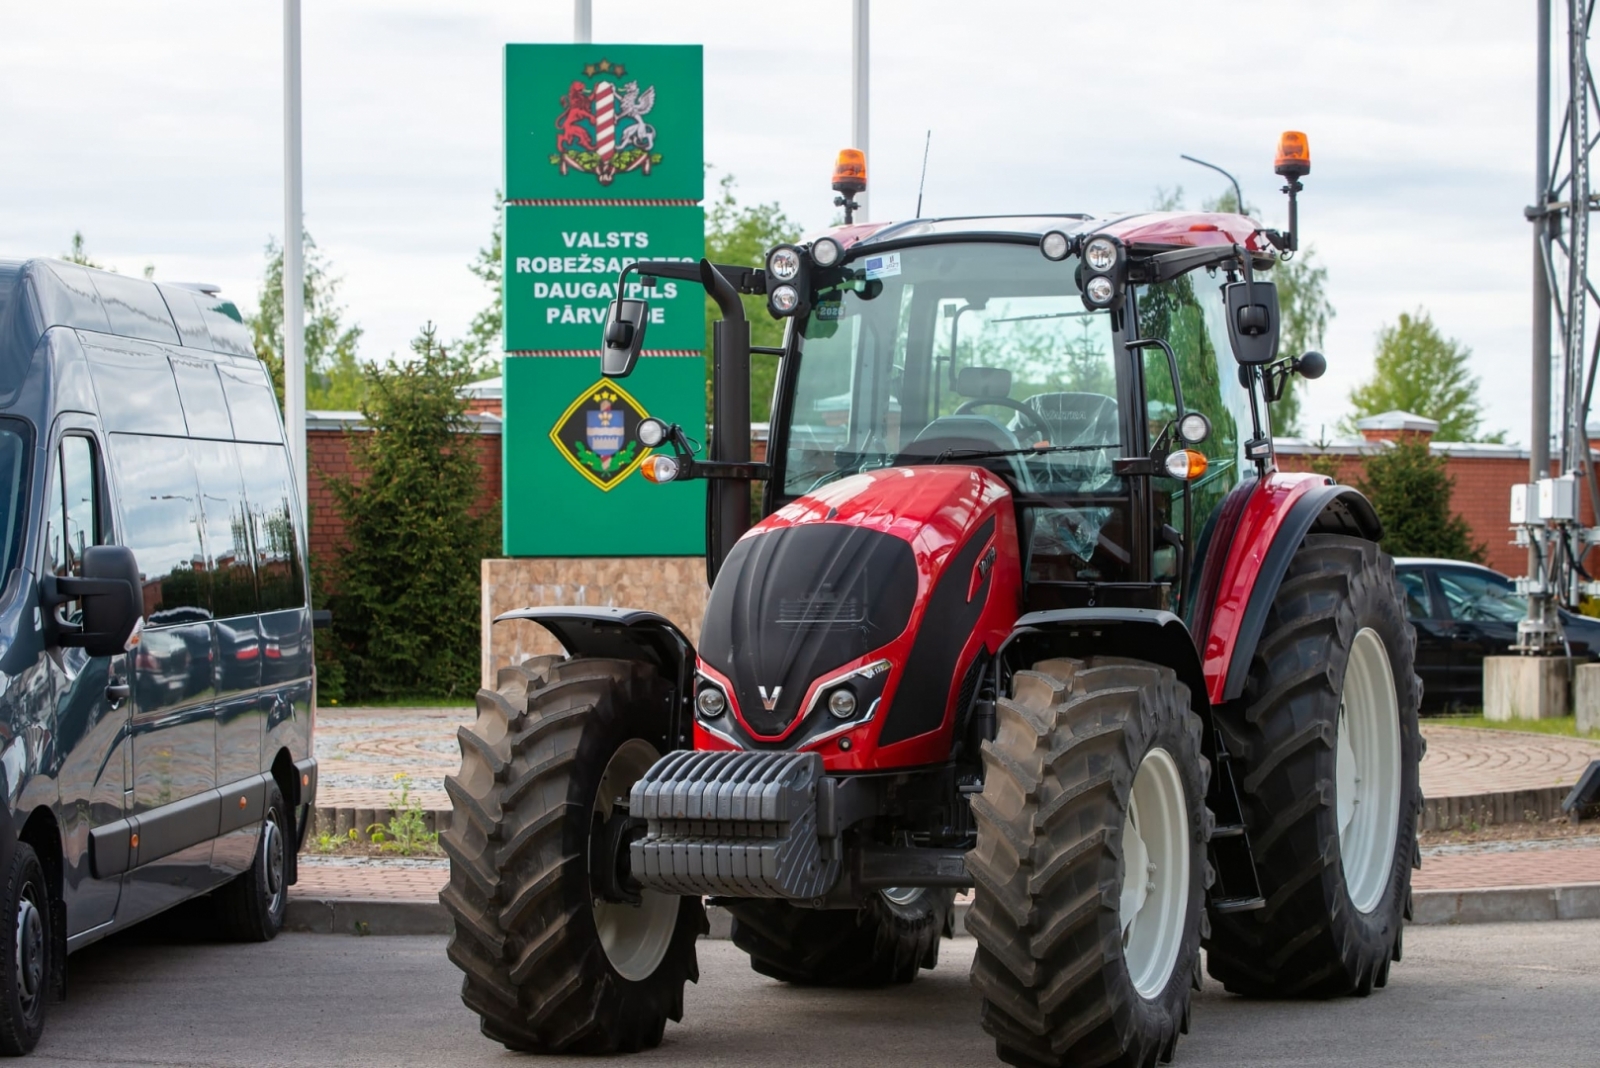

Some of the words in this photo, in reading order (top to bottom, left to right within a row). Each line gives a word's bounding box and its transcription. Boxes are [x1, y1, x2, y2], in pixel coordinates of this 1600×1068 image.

[562, 231, 649, 248] VALSTS
[516, 253, 695, 274] ROBEŽSAR
[546, 304, 666, 324] PĀRVE
